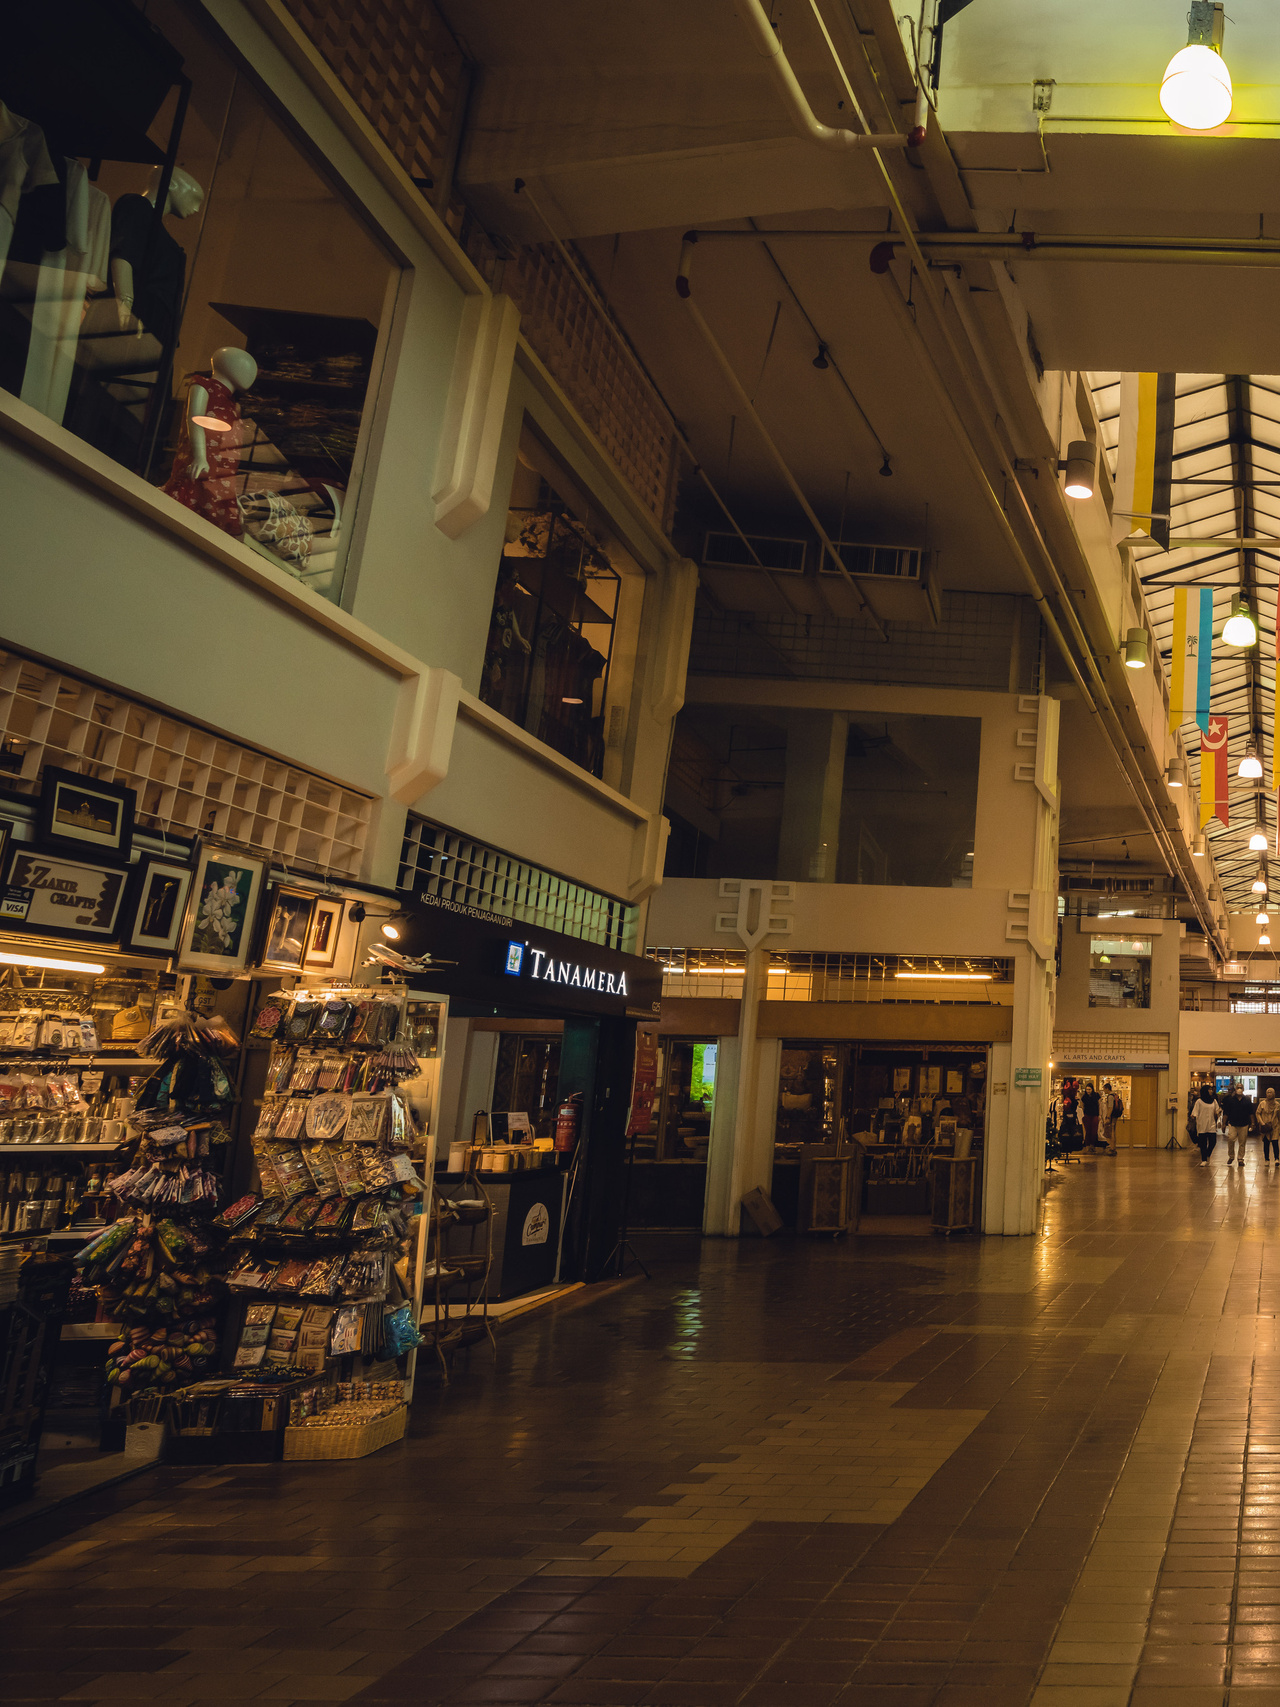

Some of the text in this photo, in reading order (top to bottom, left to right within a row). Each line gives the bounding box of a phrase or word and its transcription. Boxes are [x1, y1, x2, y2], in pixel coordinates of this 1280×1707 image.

[29, 866, 78, 893] ZAKIR
[6, 903, 24, 914] VISA
[50, 892, 97, 909] CRAFTS
[420, 892, 513, 928] KEDAI PRODUK PENJAGAAN DIRI
[530, 948, 628, 996] TANAMERA
